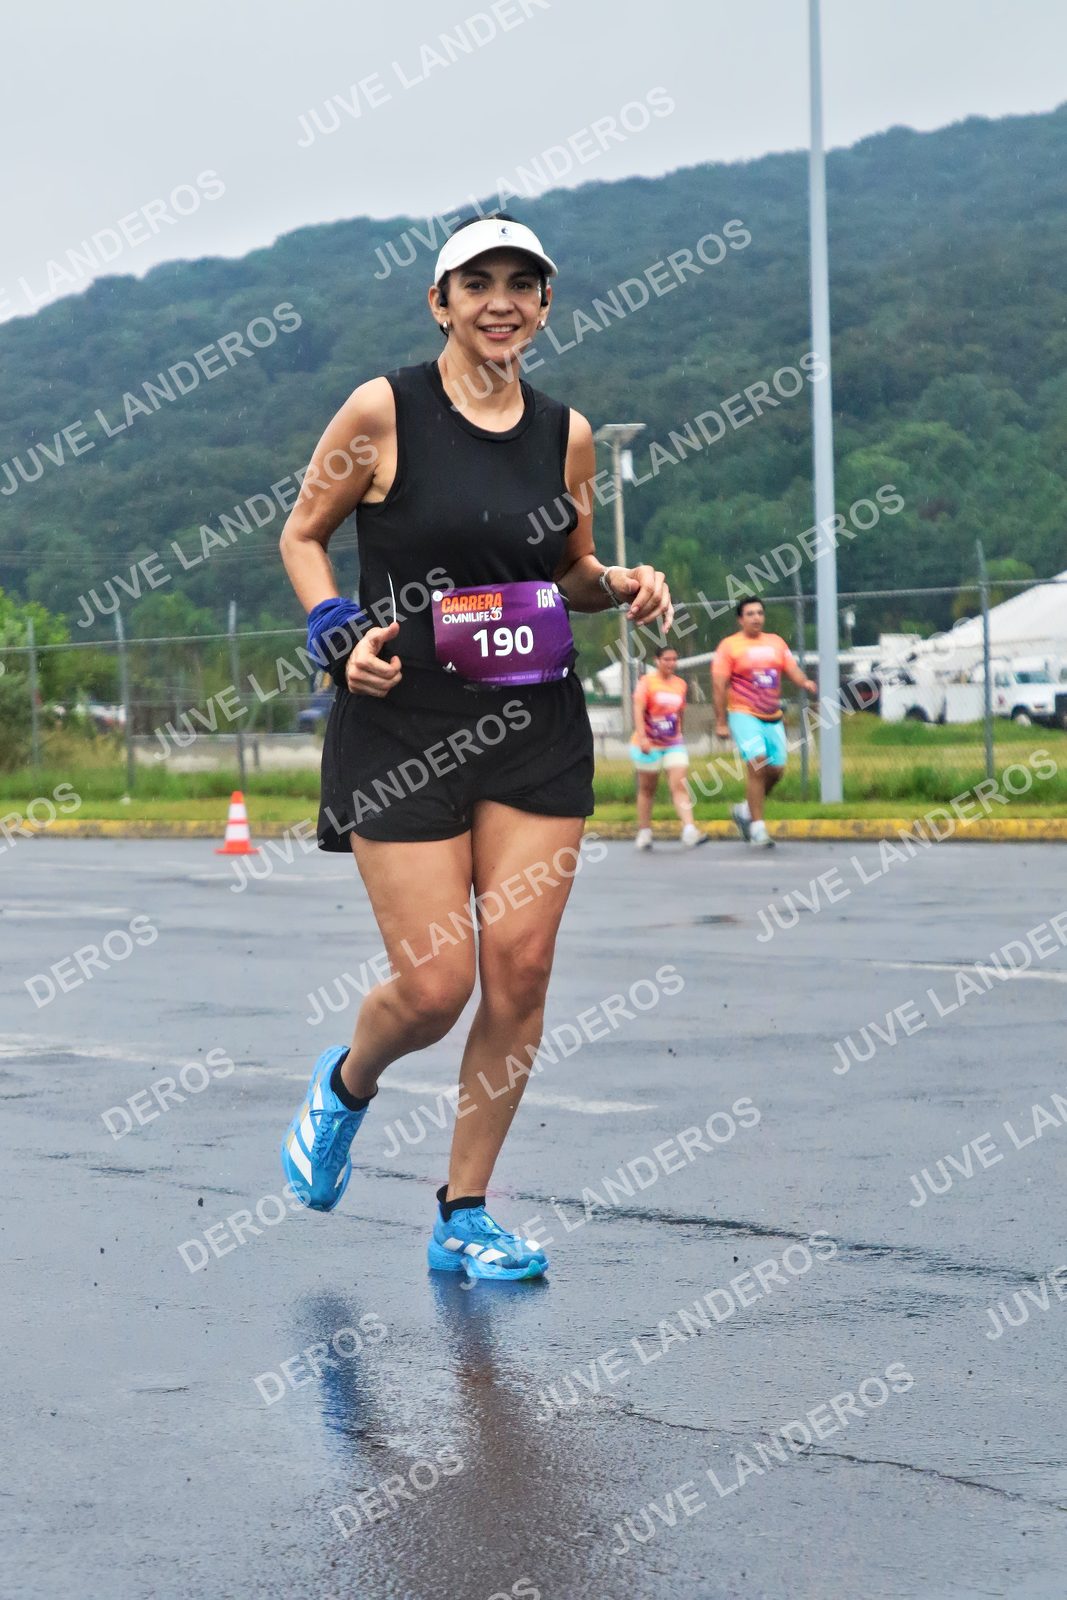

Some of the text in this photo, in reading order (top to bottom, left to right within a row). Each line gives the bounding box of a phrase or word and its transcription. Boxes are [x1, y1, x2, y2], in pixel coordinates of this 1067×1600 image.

[441, 592, 503, 613] CARRERA
[442, 609, 490, 624] OMNILIFE
[473, 625, 534, 658] 190
